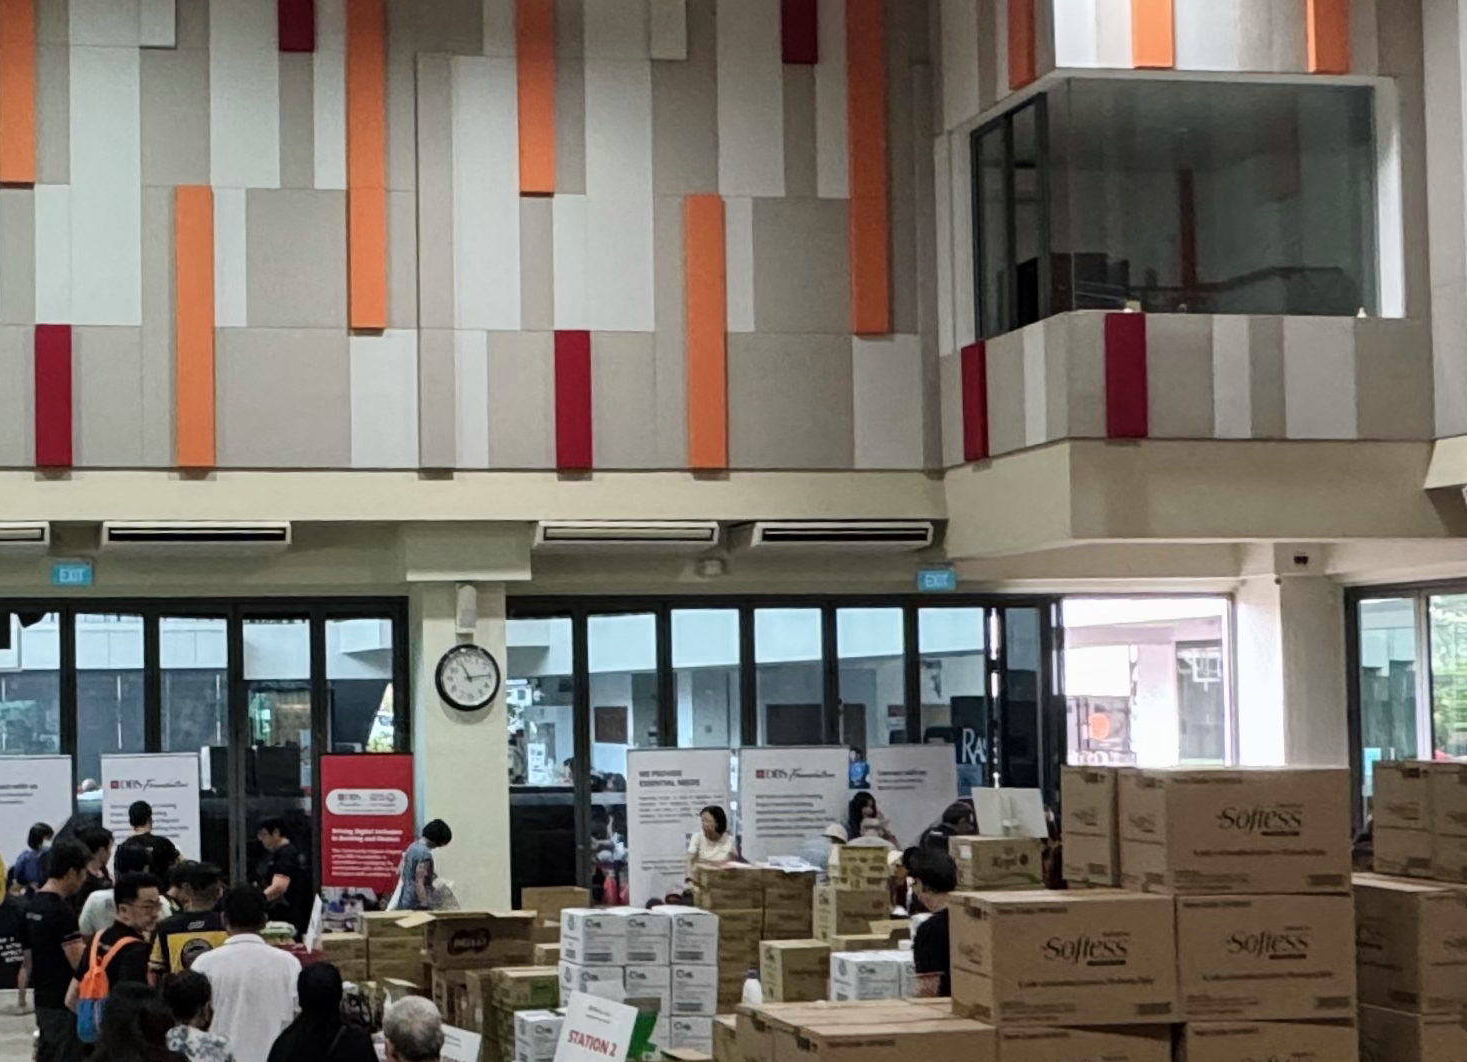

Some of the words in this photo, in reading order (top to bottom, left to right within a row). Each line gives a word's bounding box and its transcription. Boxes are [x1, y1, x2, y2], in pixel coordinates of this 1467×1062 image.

[59, 568, 85, 583] EXIT
[765, 769, 788, 779] DBS
[1216, 804, 1302, 832] Softess
[1040, 935, 1129, 964] Softess
[1226, 929, 1310, 957] Softess
[567, 1029, 610, 1056] STATION
